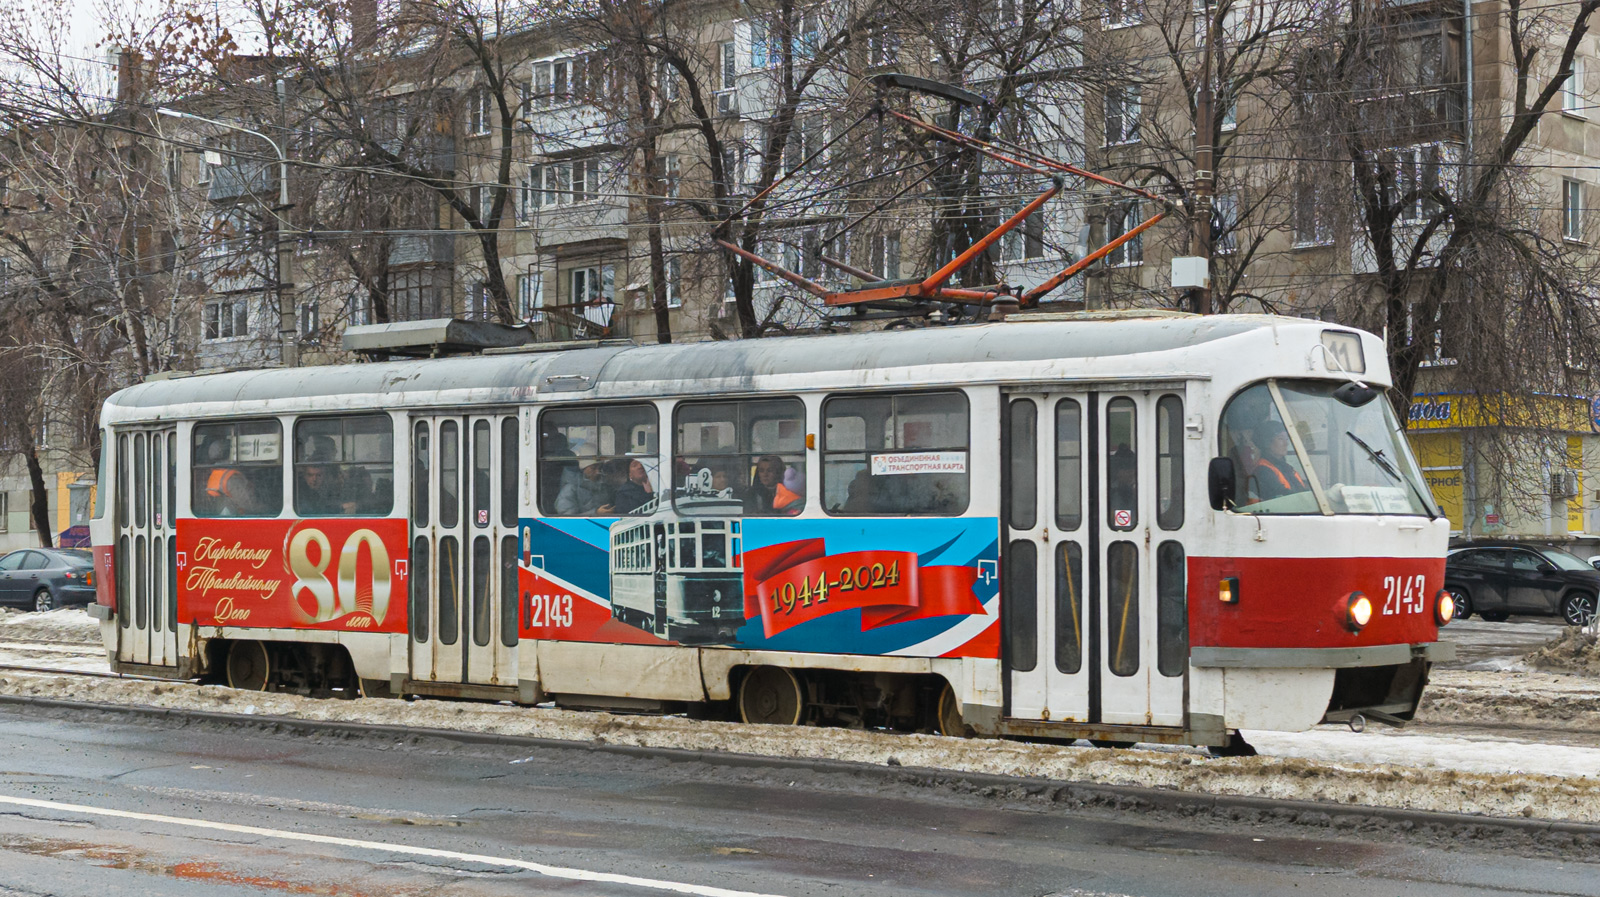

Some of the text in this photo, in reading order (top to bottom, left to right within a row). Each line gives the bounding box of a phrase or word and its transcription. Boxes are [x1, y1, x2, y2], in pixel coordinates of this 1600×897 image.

[1328, 341, 1352, 372] 11
[888, 455, 940, 463] ОБЪЕДИНЕННАЯ
[888, 464, 941, 472] ТРАНСПОРТНАЯ
[702, 471, 709, 487] 2
[194, 537, 272, 569] Кировскому
[186, 567, 281, 600] Трамвайному
[290, 528, 392, 627] 80
[770, 559, 900, 615] 1944-2024
[214, 597, 251, 624] Депо
[532, 594, 573, 627] 2143
[1383, 575, 1425, 615] 2143
[346, 616, 371, 628] лет
[712, 606, 721, 618] 12
